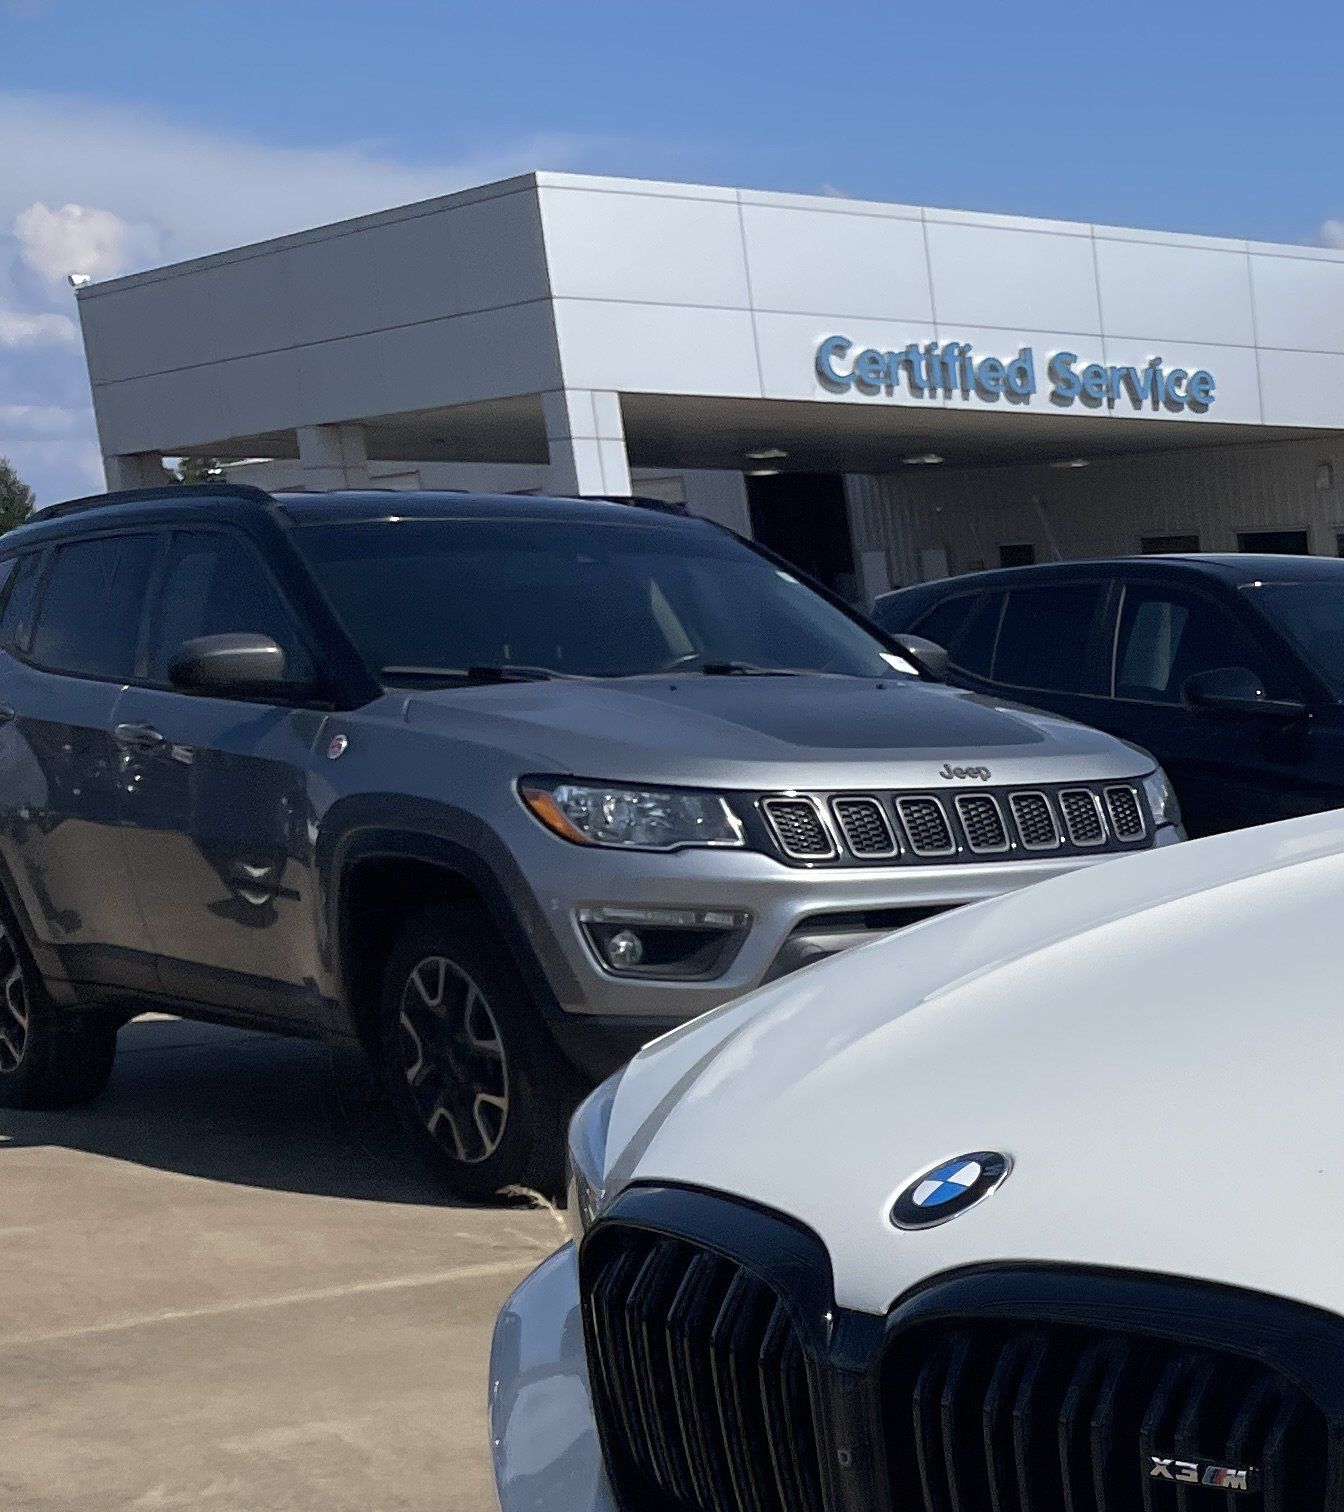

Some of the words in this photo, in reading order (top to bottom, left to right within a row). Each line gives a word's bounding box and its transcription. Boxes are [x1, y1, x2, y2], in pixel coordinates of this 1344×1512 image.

[816, 335, 1037, 398] Certified
[1047, 351, 1216, 406] Service
[939, 763, 992, 782] Jeep
